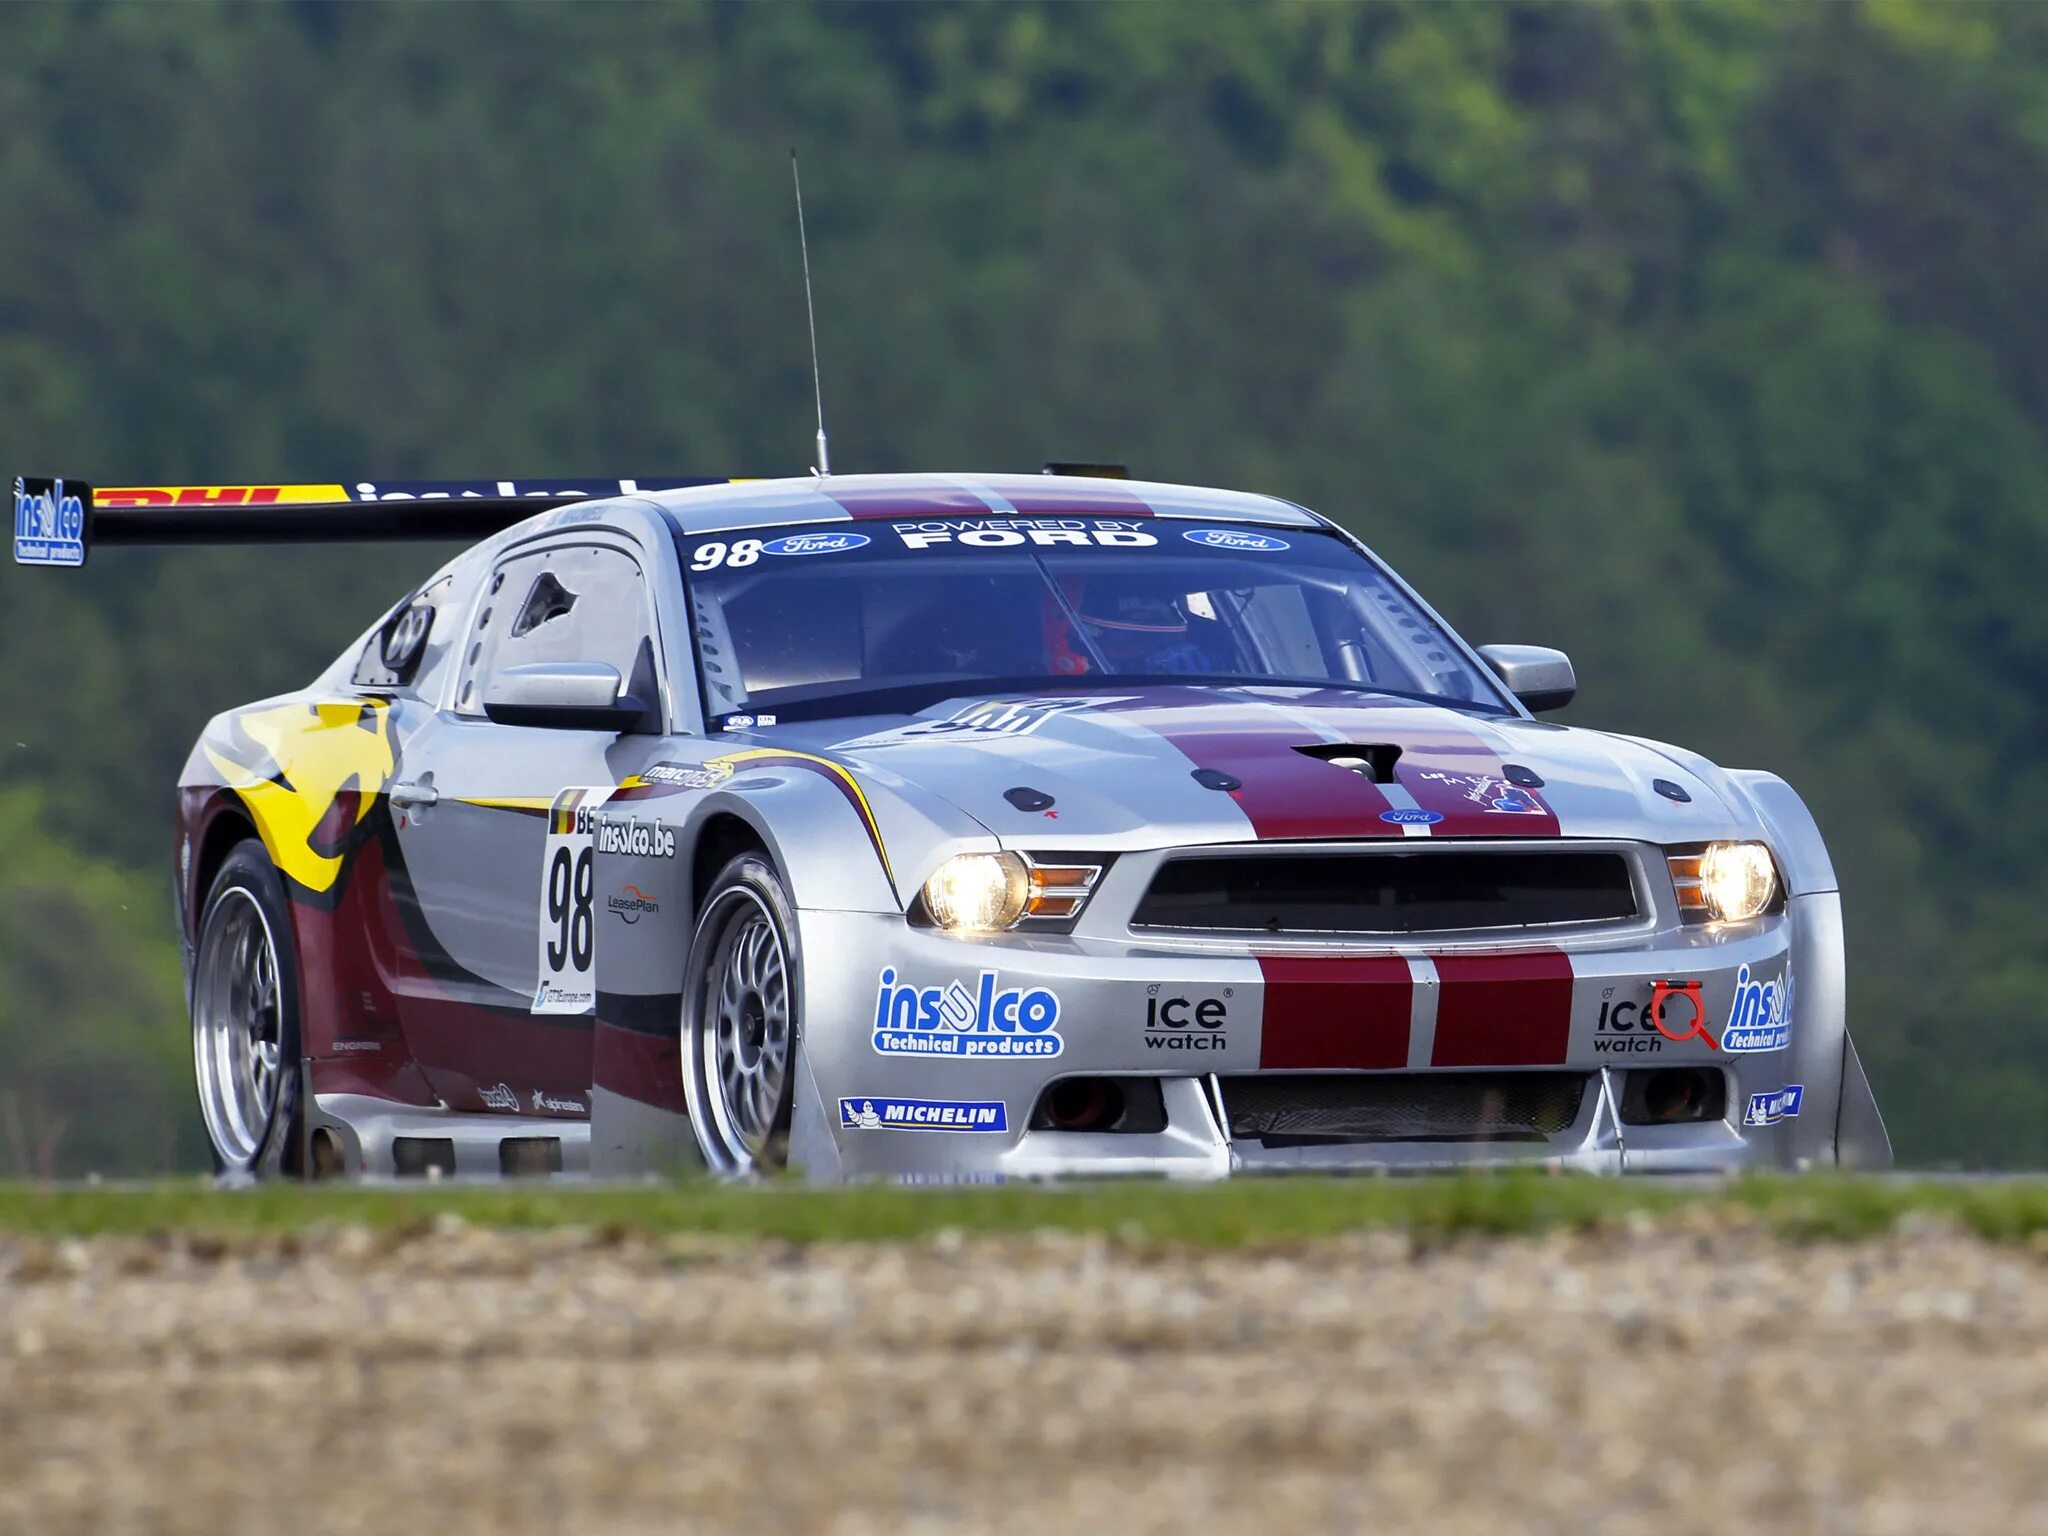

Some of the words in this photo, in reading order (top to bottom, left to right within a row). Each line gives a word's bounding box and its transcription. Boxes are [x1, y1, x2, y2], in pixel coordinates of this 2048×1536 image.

[891, 520, 1086, 534] POWERED
[1093, 521, 1144, 532] BY
[783, 535, 849, 553] Ford
[901, 530, 1158, 549] FORD
[1204, 530, 1270, 549] Ford
[690, 539, 763, 571] 98
[1392, 811, 1431, 821] Ford
[598, 814, 675, 857] insulco.be
[547, 846, 594, 972] 98
[608, 895, 659, 913] LeasePlan
[877, 968, 1057, 1033] insulco
[1730, 963, 1795, 1027] insul
[881, 1033, 959, 1053] Technical
[966, 1037, 1054, 1055] products
[1145, 1034, 1226, 1050] watch
[1594, 1036, 1662, 1052] watch
[1730, 1030, 1774, 1049] Technical
[885, 1105, 997, 1124] MICHELIN
